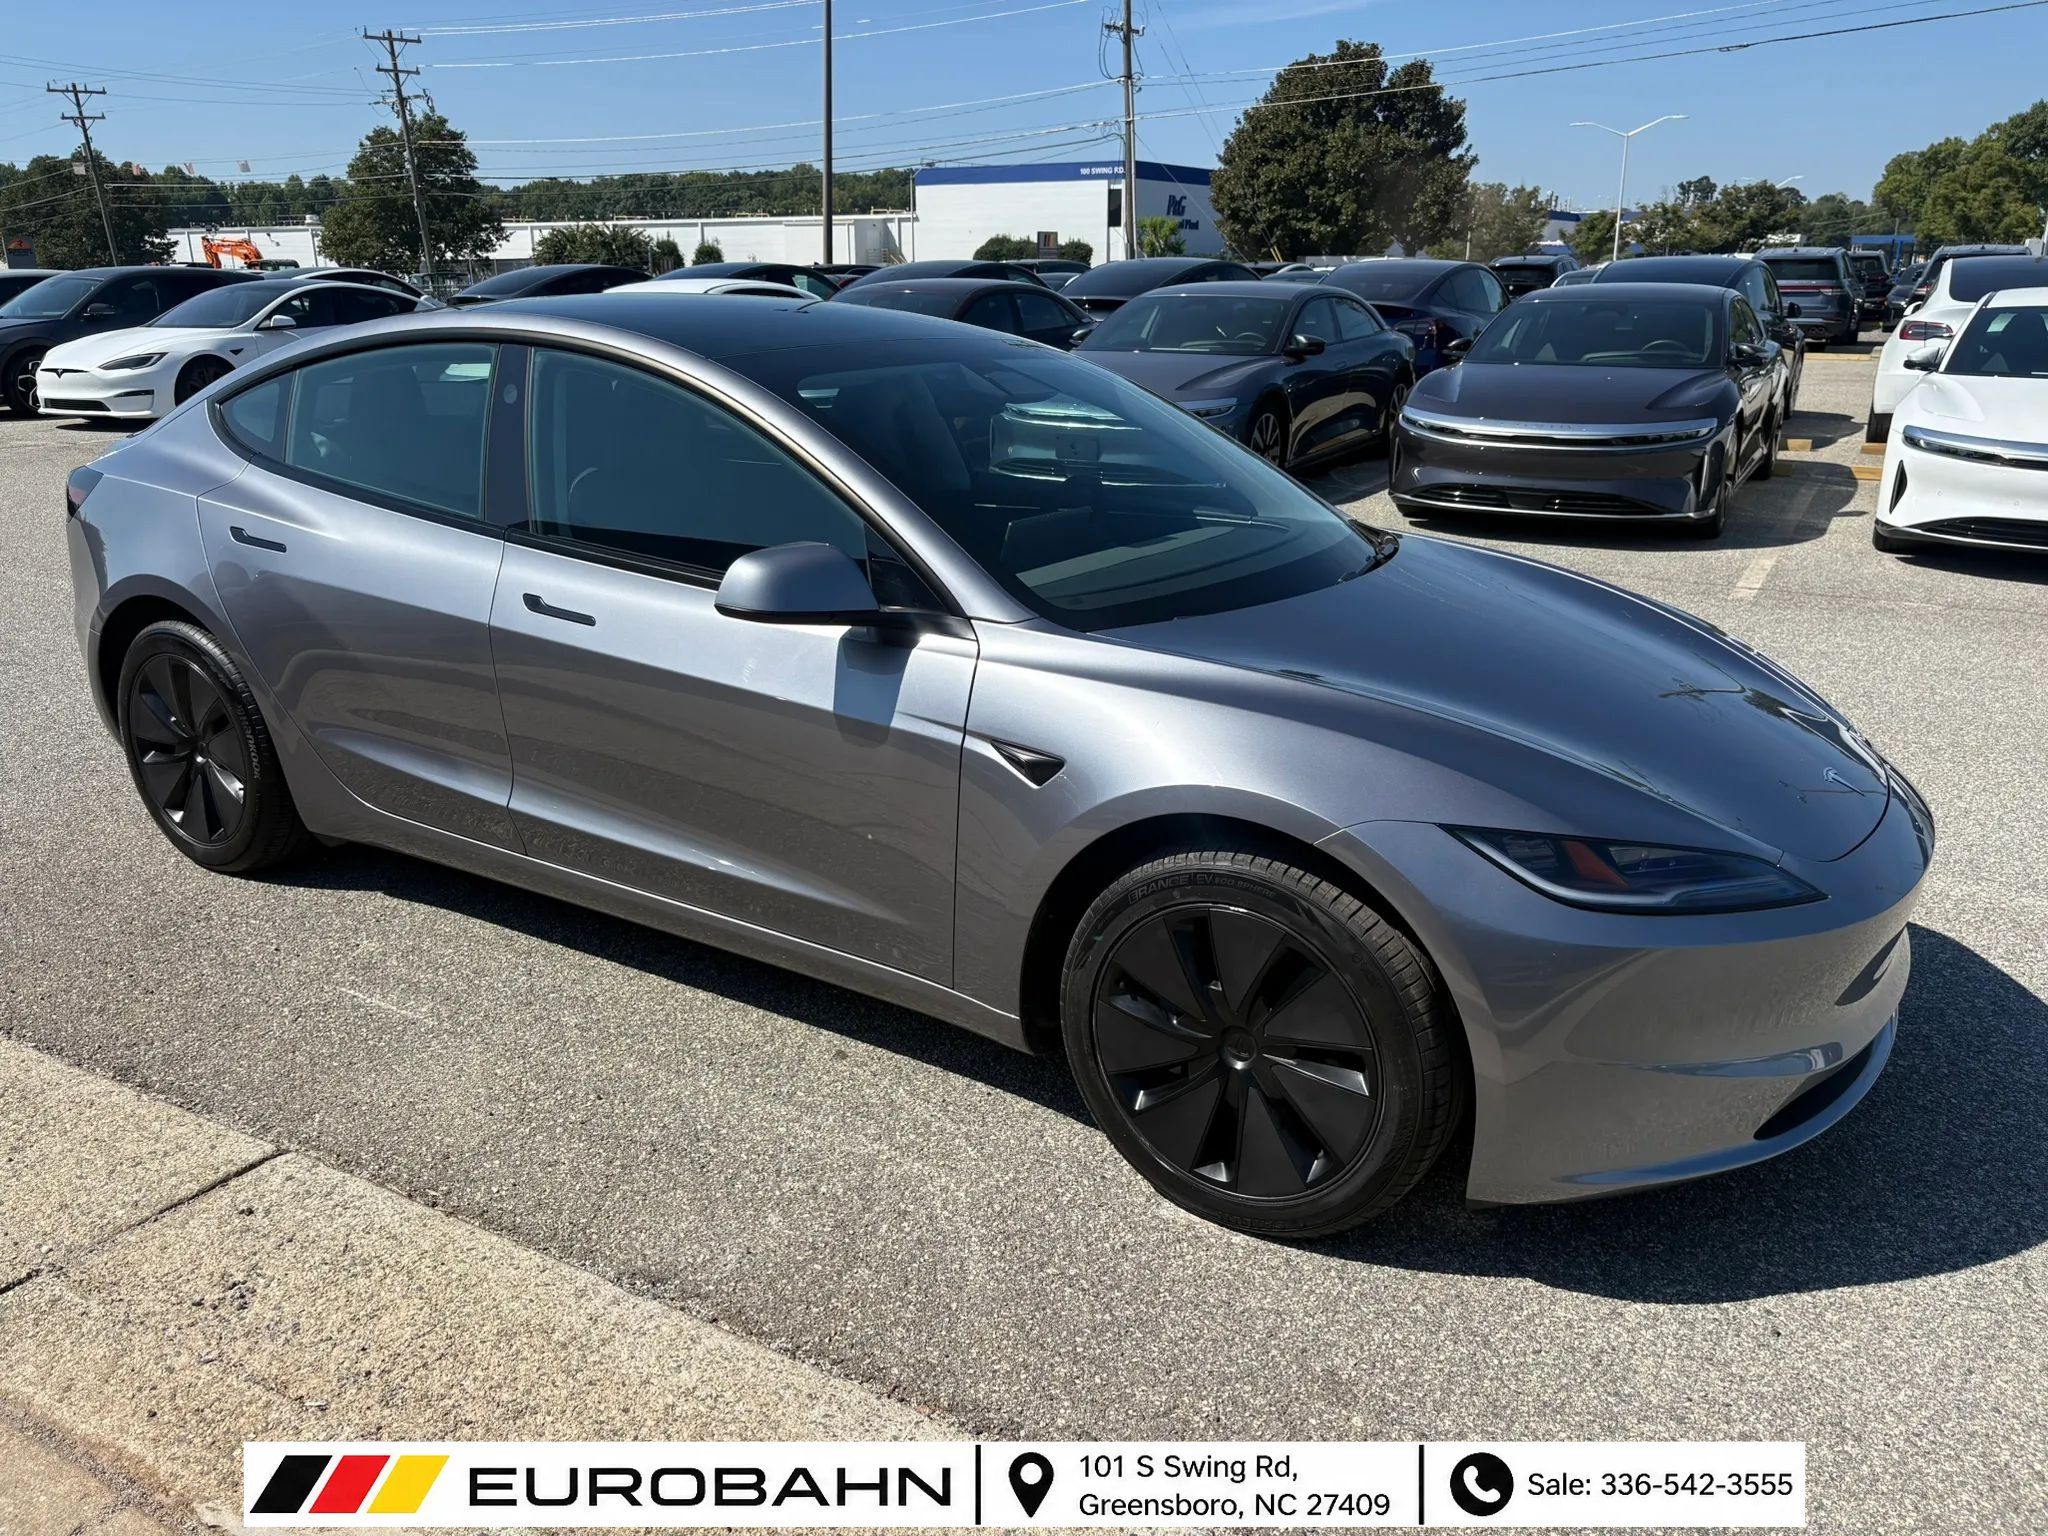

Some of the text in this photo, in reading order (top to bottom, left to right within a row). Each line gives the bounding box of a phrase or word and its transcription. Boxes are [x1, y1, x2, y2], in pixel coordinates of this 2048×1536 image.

[1080, 167, 1091, 176] 100
[1091, 166, 1113, 175] SWING
[1196, 873, 1214, 885] EV
